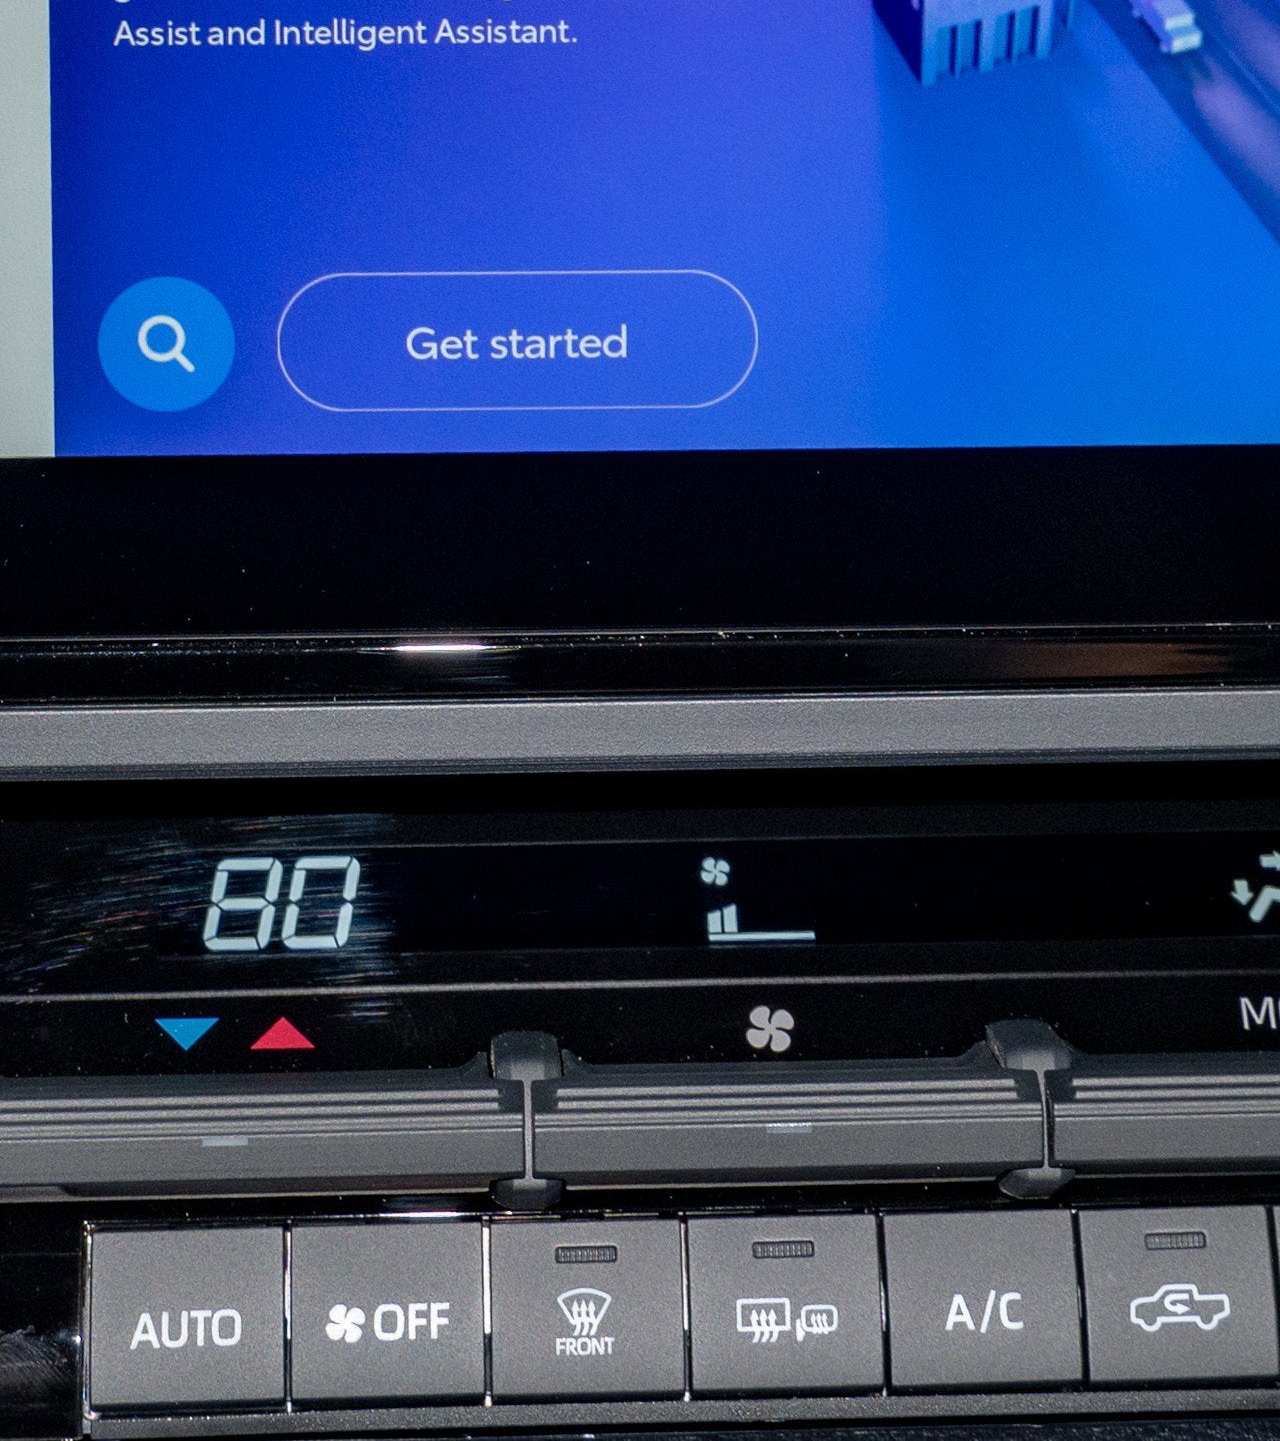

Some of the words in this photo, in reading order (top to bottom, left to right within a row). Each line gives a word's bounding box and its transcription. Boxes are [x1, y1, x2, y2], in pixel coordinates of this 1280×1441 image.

[112, 19, 201, 48] Assist
[206, 19, 267, 46] and
[273, 17, 428, 52] Intelligent
[433, 18, 579, 46] Assistant.
[405, 326, 480, 361] Get
[489, 322, 629, 359] started
[202, 854, 363, 952] 80
[129, 1309, 243, 1350] AUTO
[372, 1300, 451, 1341] OFF
[944, 1289, 1025, 1334] A/C
[554, 1335, 616, 1356] FRONT
